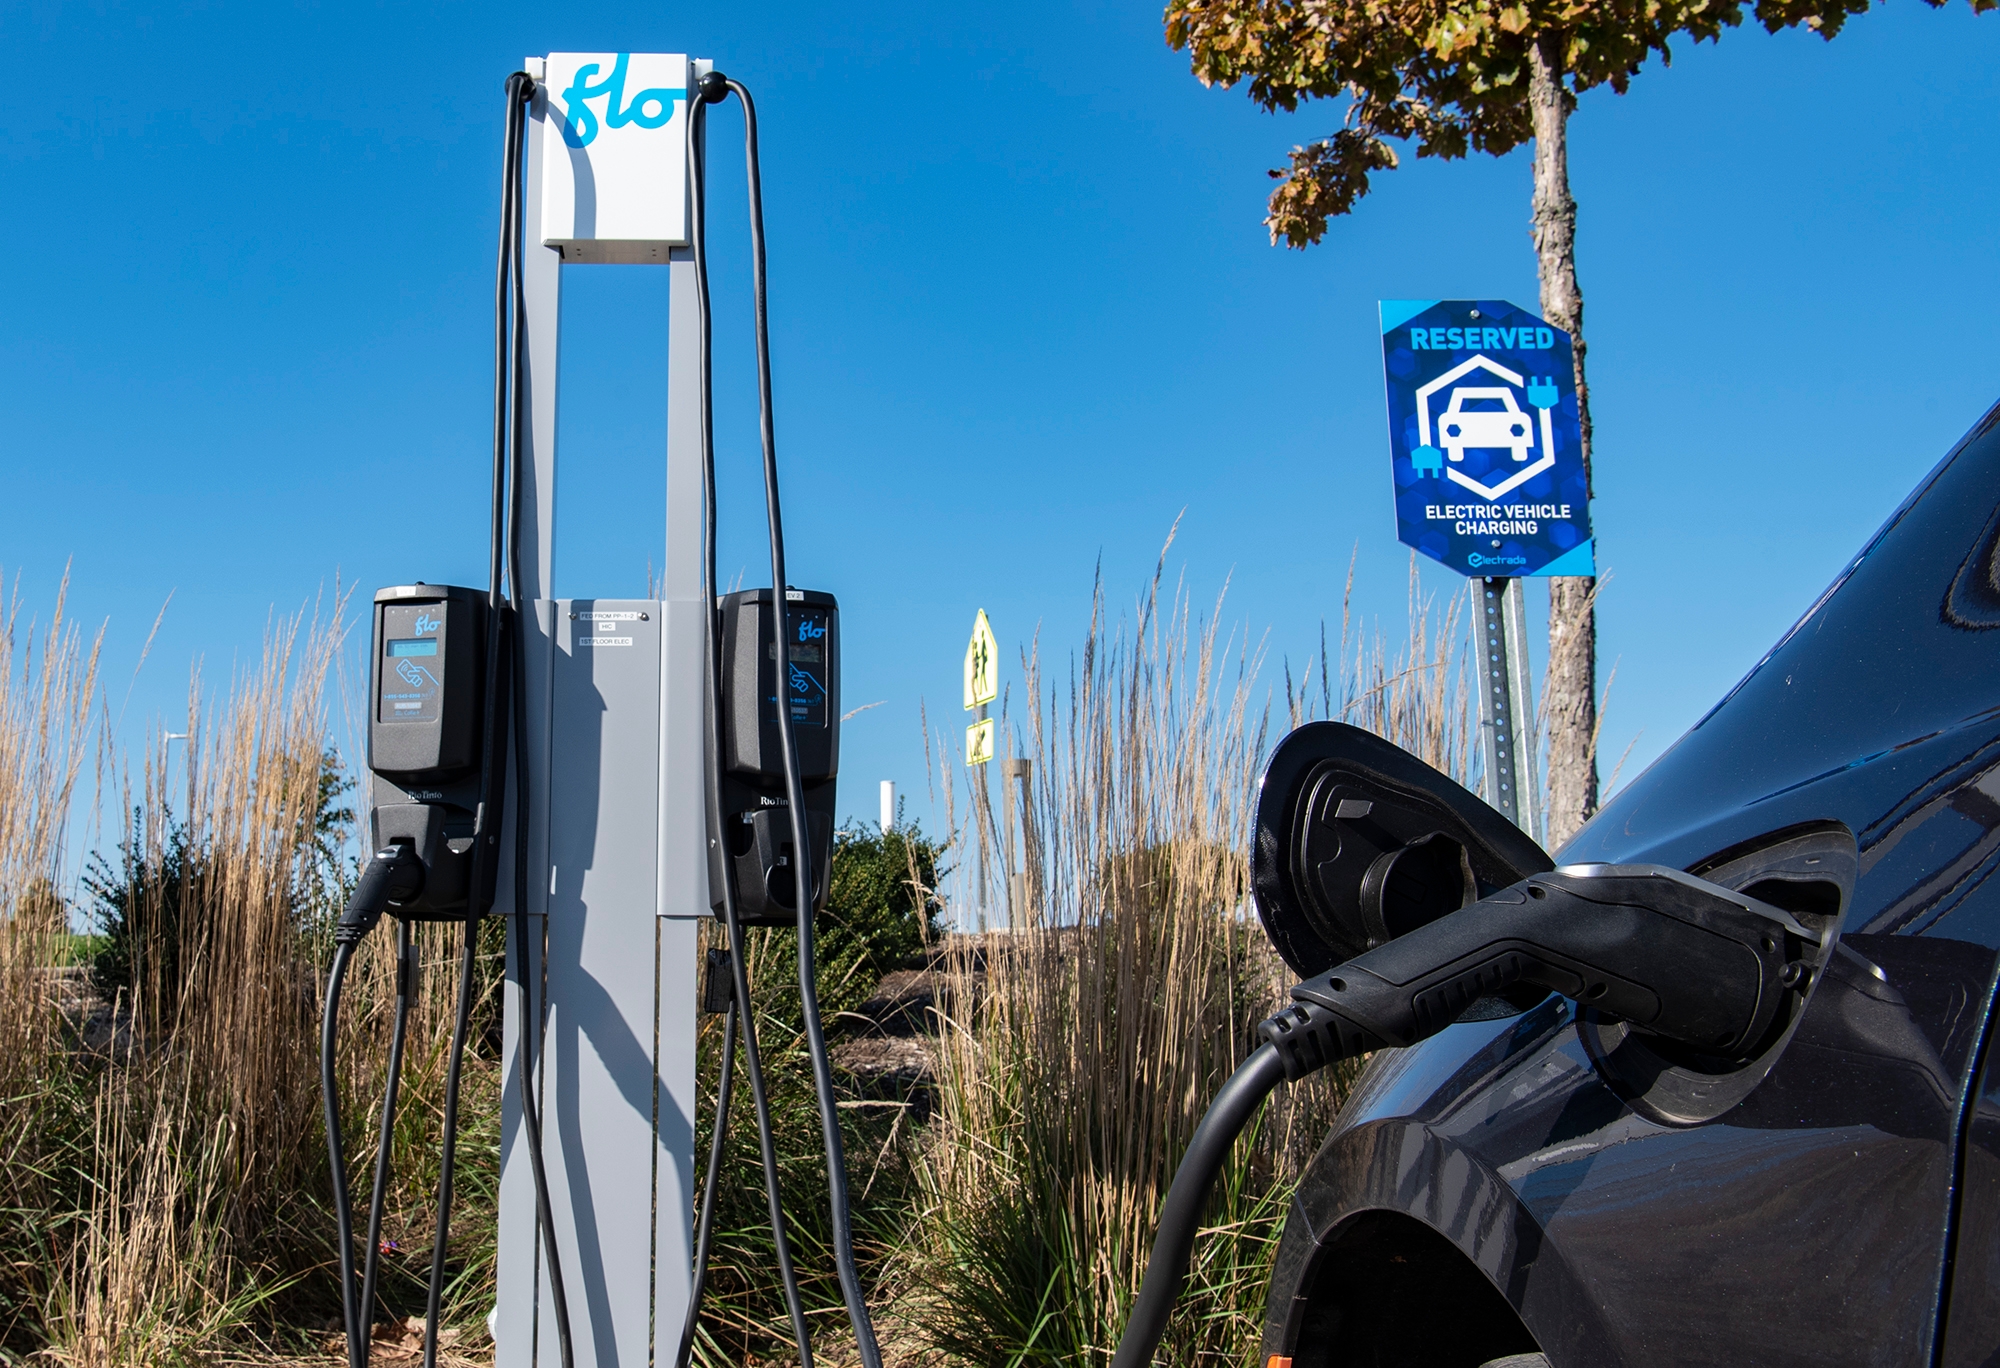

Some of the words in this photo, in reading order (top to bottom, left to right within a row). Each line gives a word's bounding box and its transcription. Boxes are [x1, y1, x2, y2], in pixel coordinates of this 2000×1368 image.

[561, 52, 687, 149] flo
[1410, 327, 1554, 350] RESERVED
[1425, 504, 1502, 520] ELECTRIC
[1503, 504, 1571, 519] VEHICLE
[1455, 520, 1538, 535] CHARGING
[415, 614, 441, 637] flo
[798, 620, 826, 642] flo
[760, 796, 789, 806] RioTin
